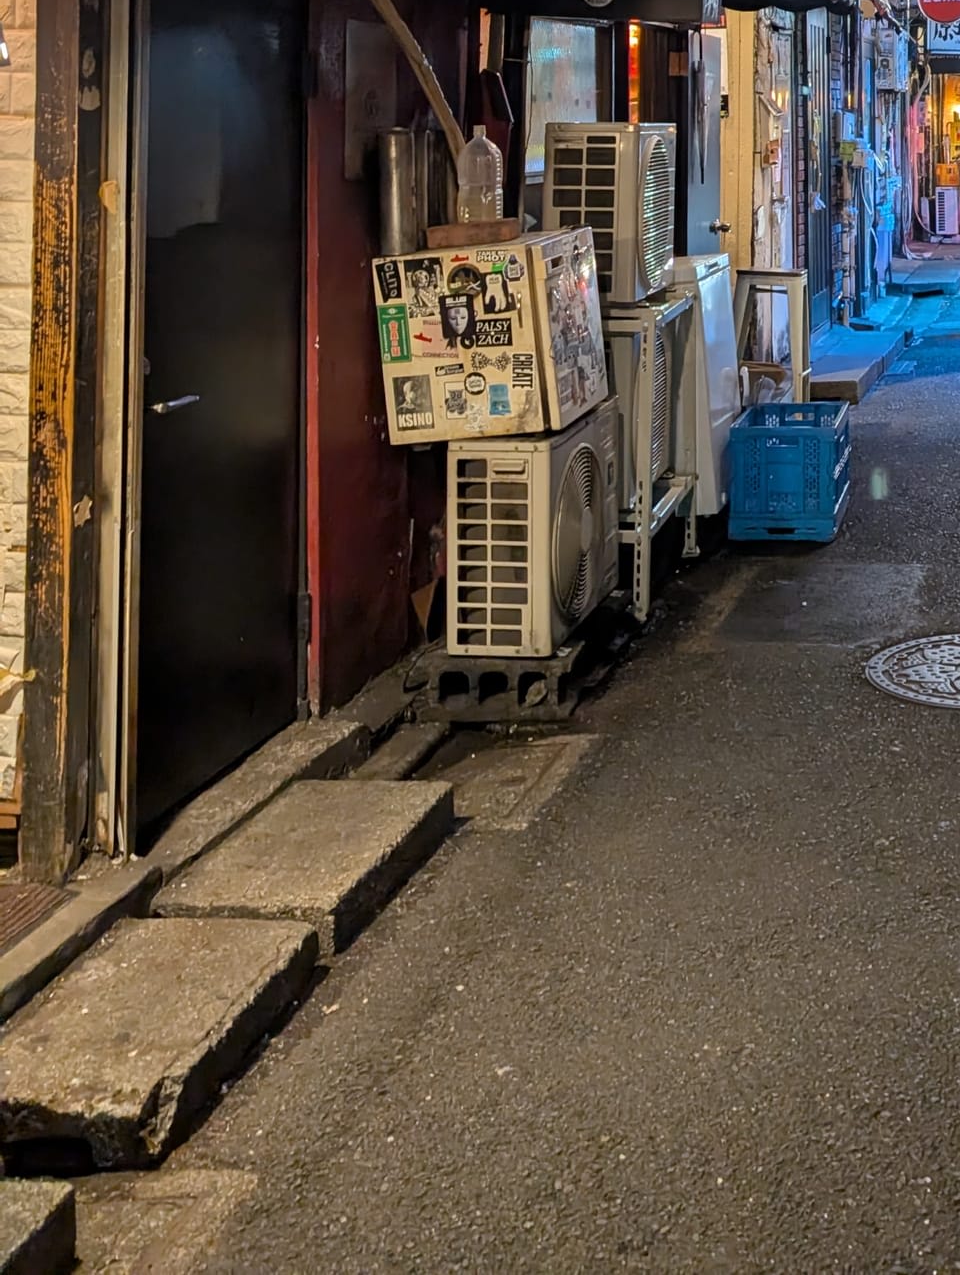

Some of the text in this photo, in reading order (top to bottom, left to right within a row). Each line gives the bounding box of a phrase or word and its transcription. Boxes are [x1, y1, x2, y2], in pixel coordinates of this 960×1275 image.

[475, 320, 511, 333] PALSY
[477, 333, 510, 346] ZACH
[512, 353, 534, 390] CREATE
